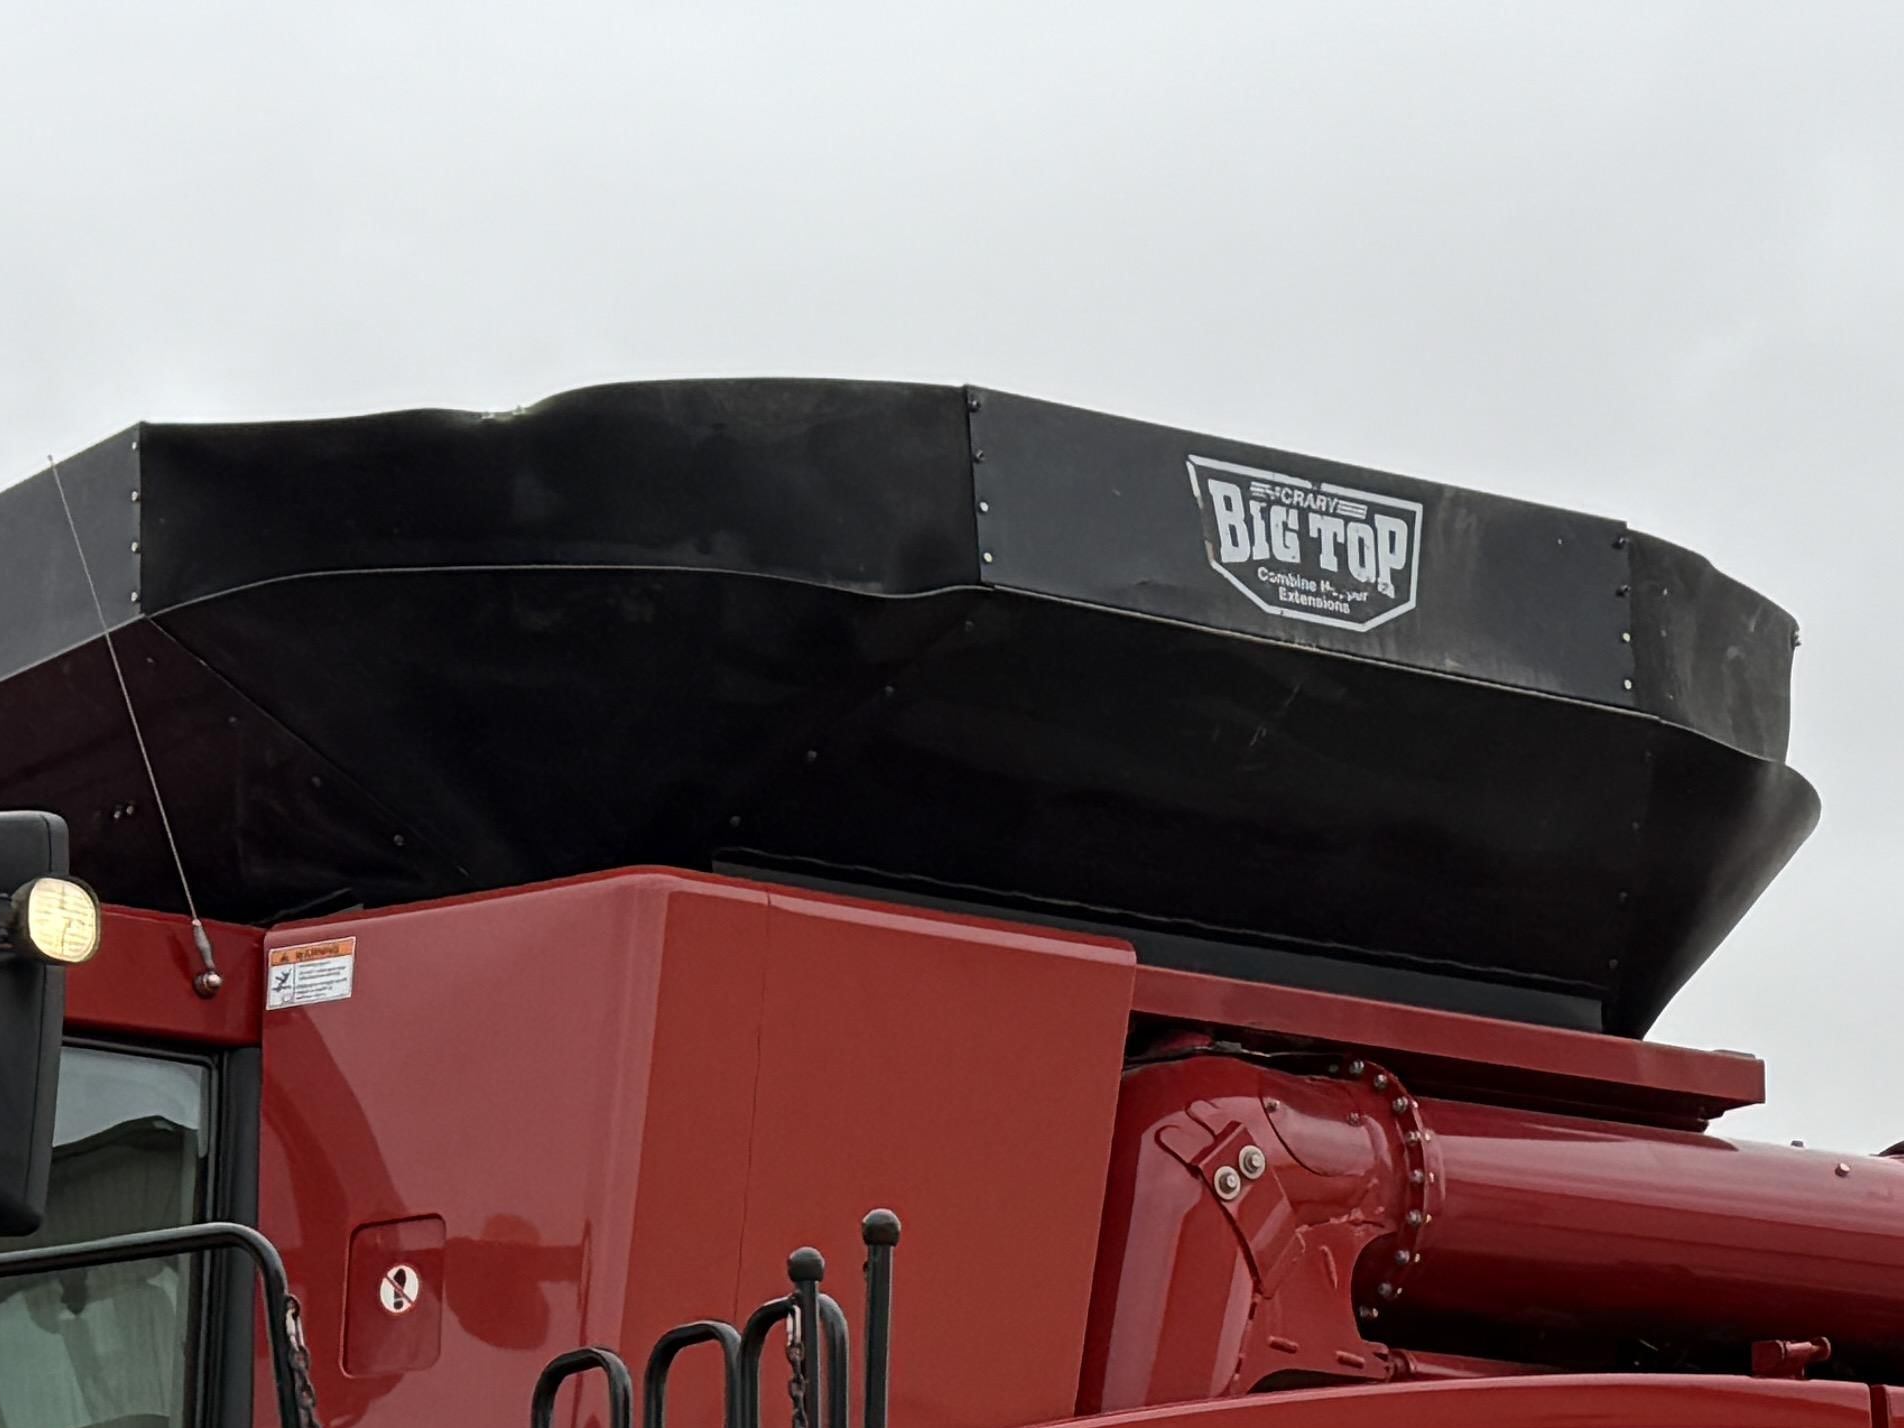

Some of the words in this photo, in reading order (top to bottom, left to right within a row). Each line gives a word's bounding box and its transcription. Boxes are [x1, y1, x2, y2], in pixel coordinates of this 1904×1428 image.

[1280, 488, 1339, 514] CRARY
[1207, 478, 1301, 564] BIG
[1308, 512, 1409, 599] TOP
[1256, 566, 1318, 593] Combine
[1278, 586, 1351, 615] Extensions
